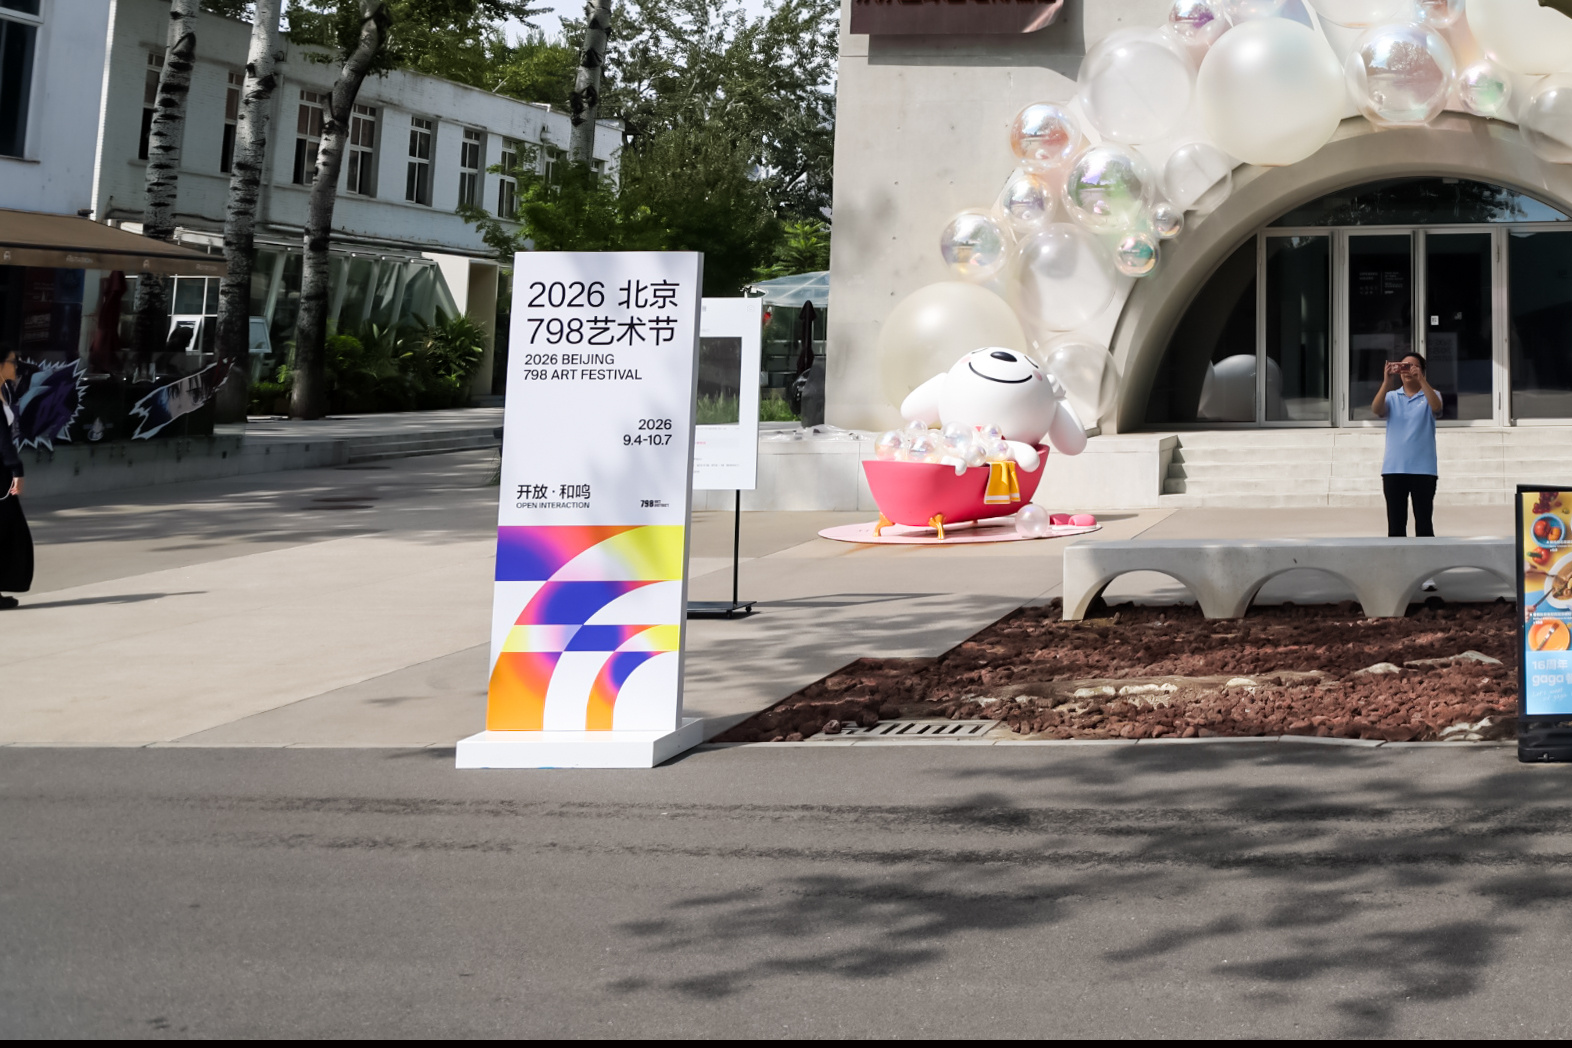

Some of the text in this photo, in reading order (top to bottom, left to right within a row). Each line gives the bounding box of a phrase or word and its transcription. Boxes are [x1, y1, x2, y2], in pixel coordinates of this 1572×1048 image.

[527, 279, 681, 310] 2026 北京
[526, 315, 679, 347] 798艺术节
[524, 353, 615, 366] 2026 BEIJING
[523, 369, 643, 381] 798 ART FESTIVAL
[638, 418, 672, 431] 2026
[623, 434, 673, 446] 9.4-10.7
[640, 499, 655, 508] 798
[1532, 673, 1565, 687] gaga
